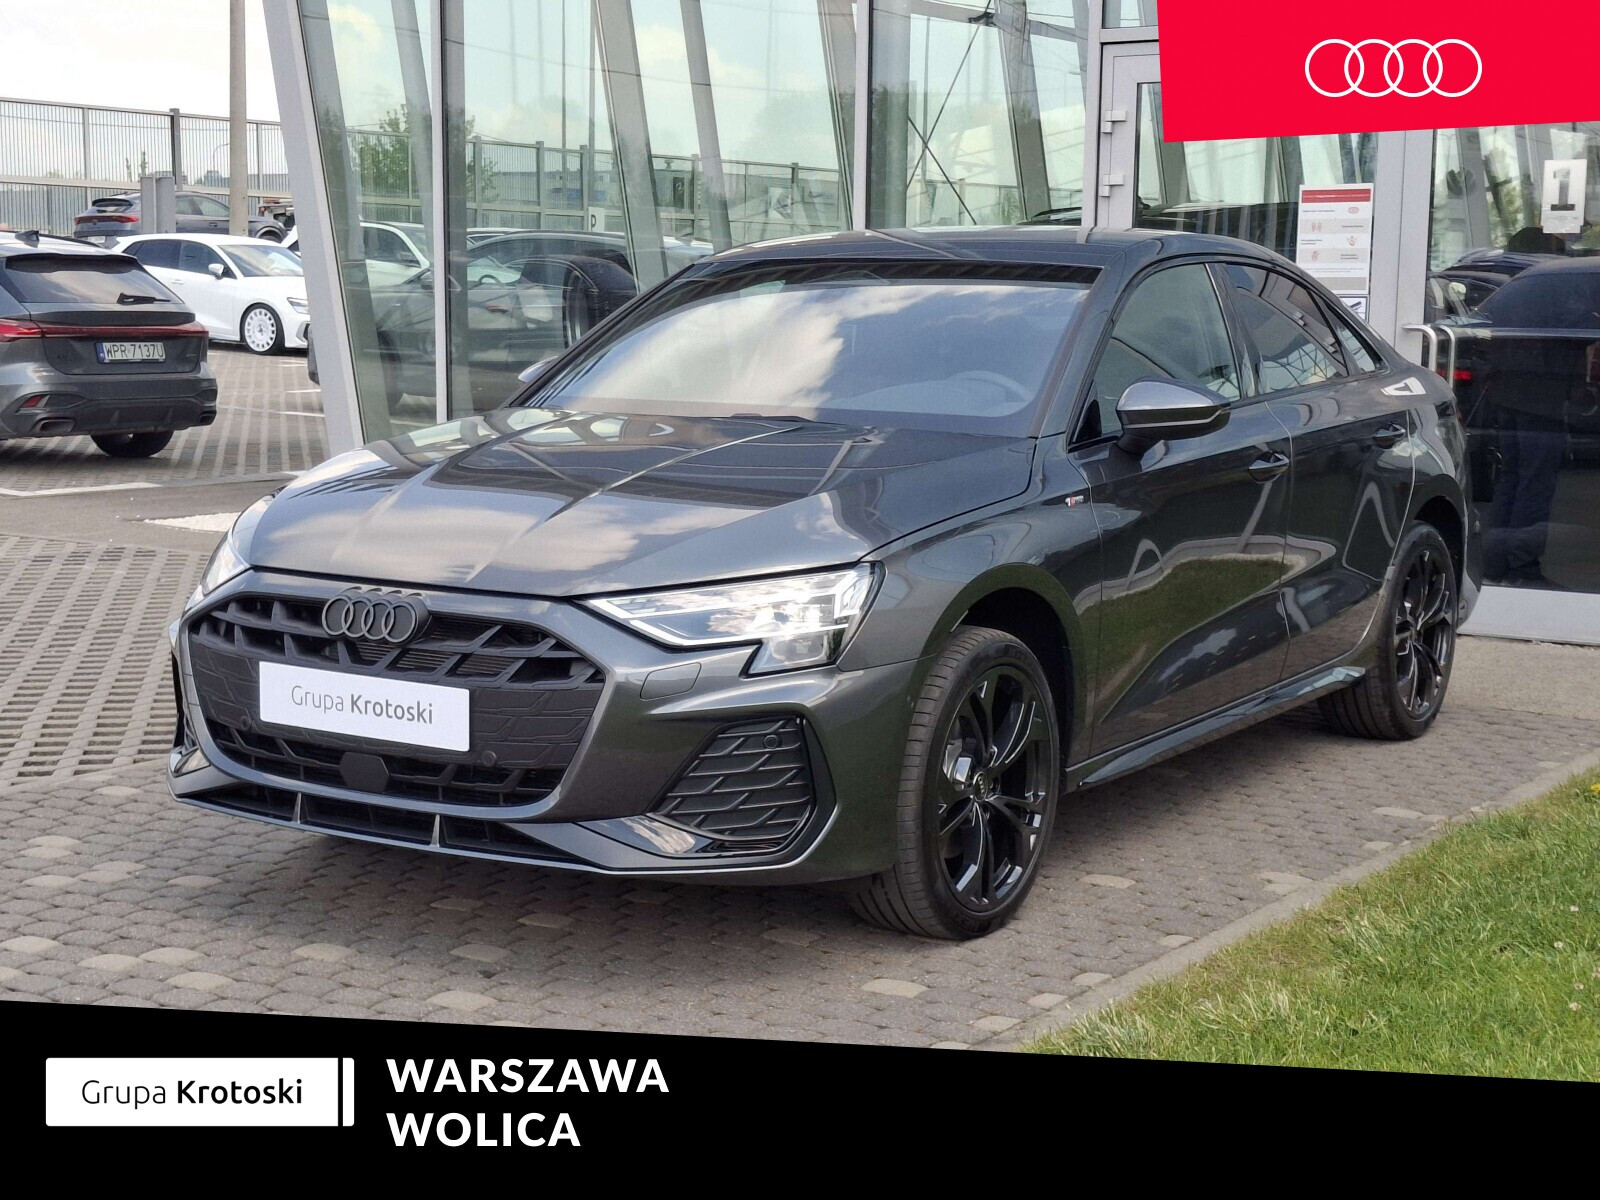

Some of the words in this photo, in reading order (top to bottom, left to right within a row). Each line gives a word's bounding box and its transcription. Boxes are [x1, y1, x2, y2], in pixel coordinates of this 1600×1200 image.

[104, 343, 129, 359] WPR
[130, 343, 164, 358] 7137U
[291, 685, 344, 714] Grupa
[350, 693, 433, 725] Krotoski
